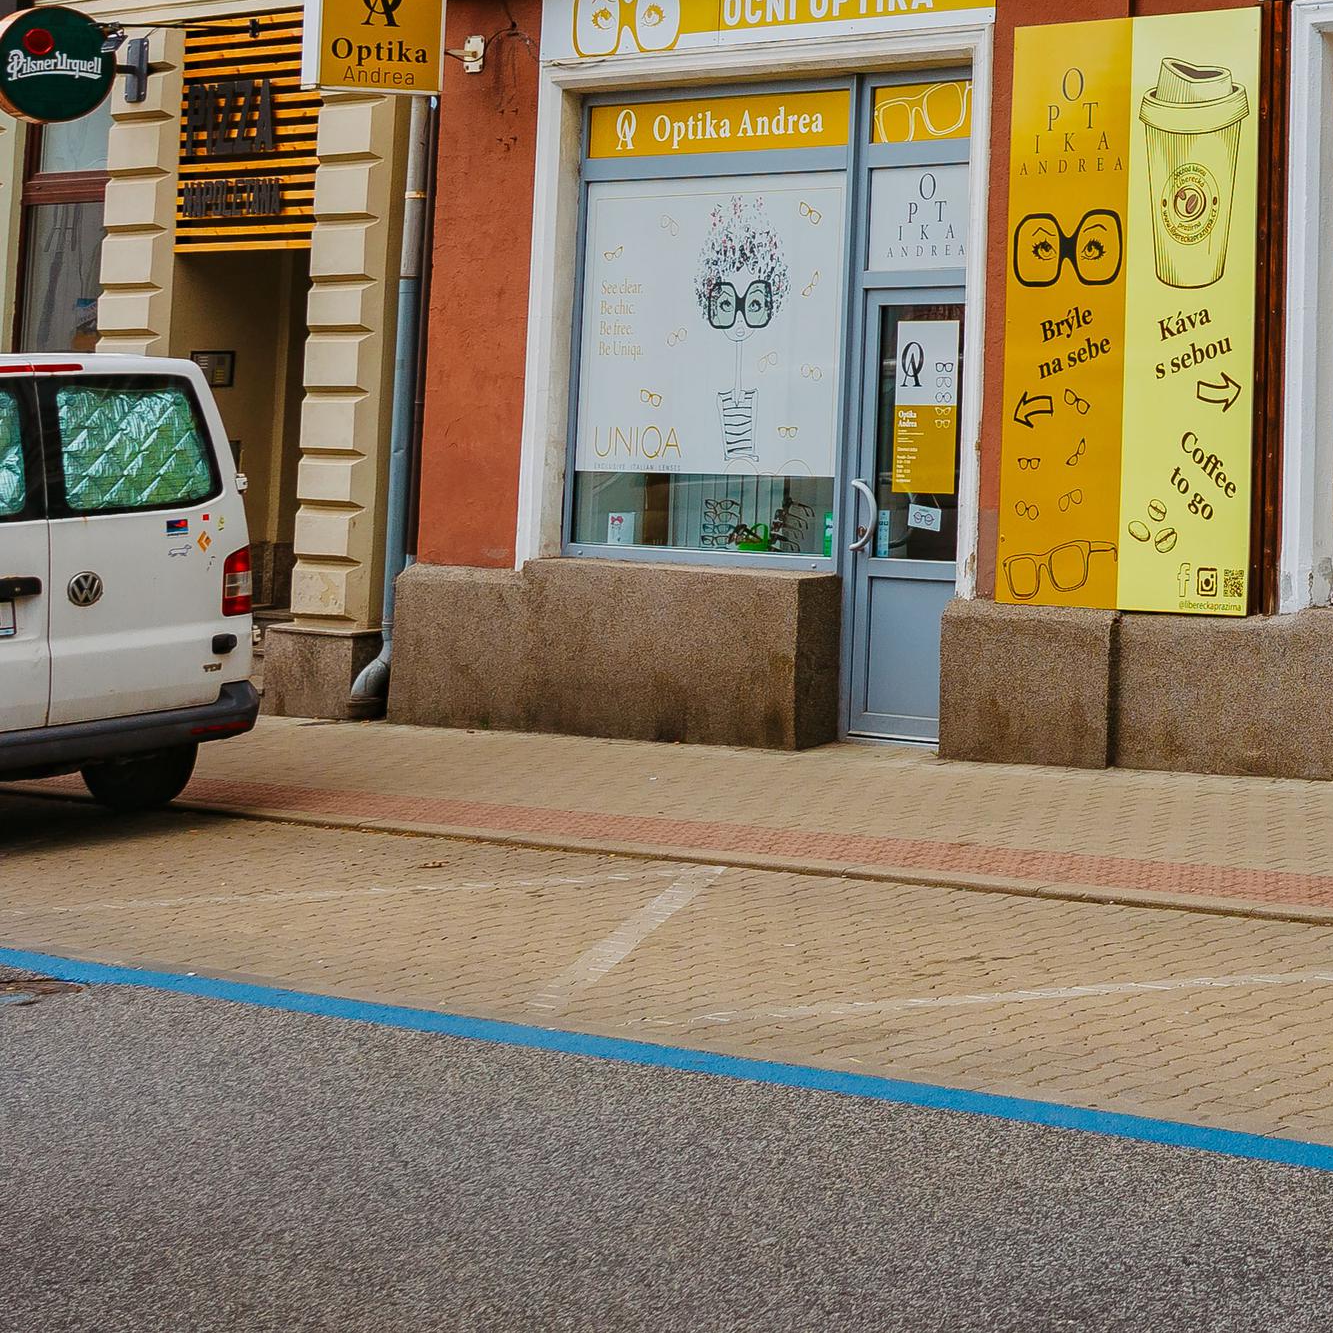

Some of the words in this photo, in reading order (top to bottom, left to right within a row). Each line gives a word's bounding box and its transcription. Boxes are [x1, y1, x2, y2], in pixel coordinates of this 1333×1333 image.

[7, 50, 58, 81] Pilsner
[55, 51, 102, 78] Urquell
[331, 38, 428, 66] Optika
[343, 66, 414, 85] Andrea
[187, 79, 273, 156] PIZZA
[653, 110, 731, 149] Optika
[738, 106, 823, 139] Andrea
[601, 279, 617, 294] See
[600, 300, 612, 315] Be
[1040, 306, 1093, 342] Brýle
[1158, 307, 1212, 341] Káva
[600, 321, 611, 335] Be
[599, 341, 611, 355] Be
[1038, 359, 1063, 379] na
[1068, 335, 1112, 368] sebe
[1155, 362, 1166, 379] s
[1170, 336, 1233, 375] sebou
[595, 426, 681, 458] UNIQA
[1181, 431, 1237, 499] Coffee
[1171, 466, 1190, 495] to
[1187, 492, 1214, 520] go
